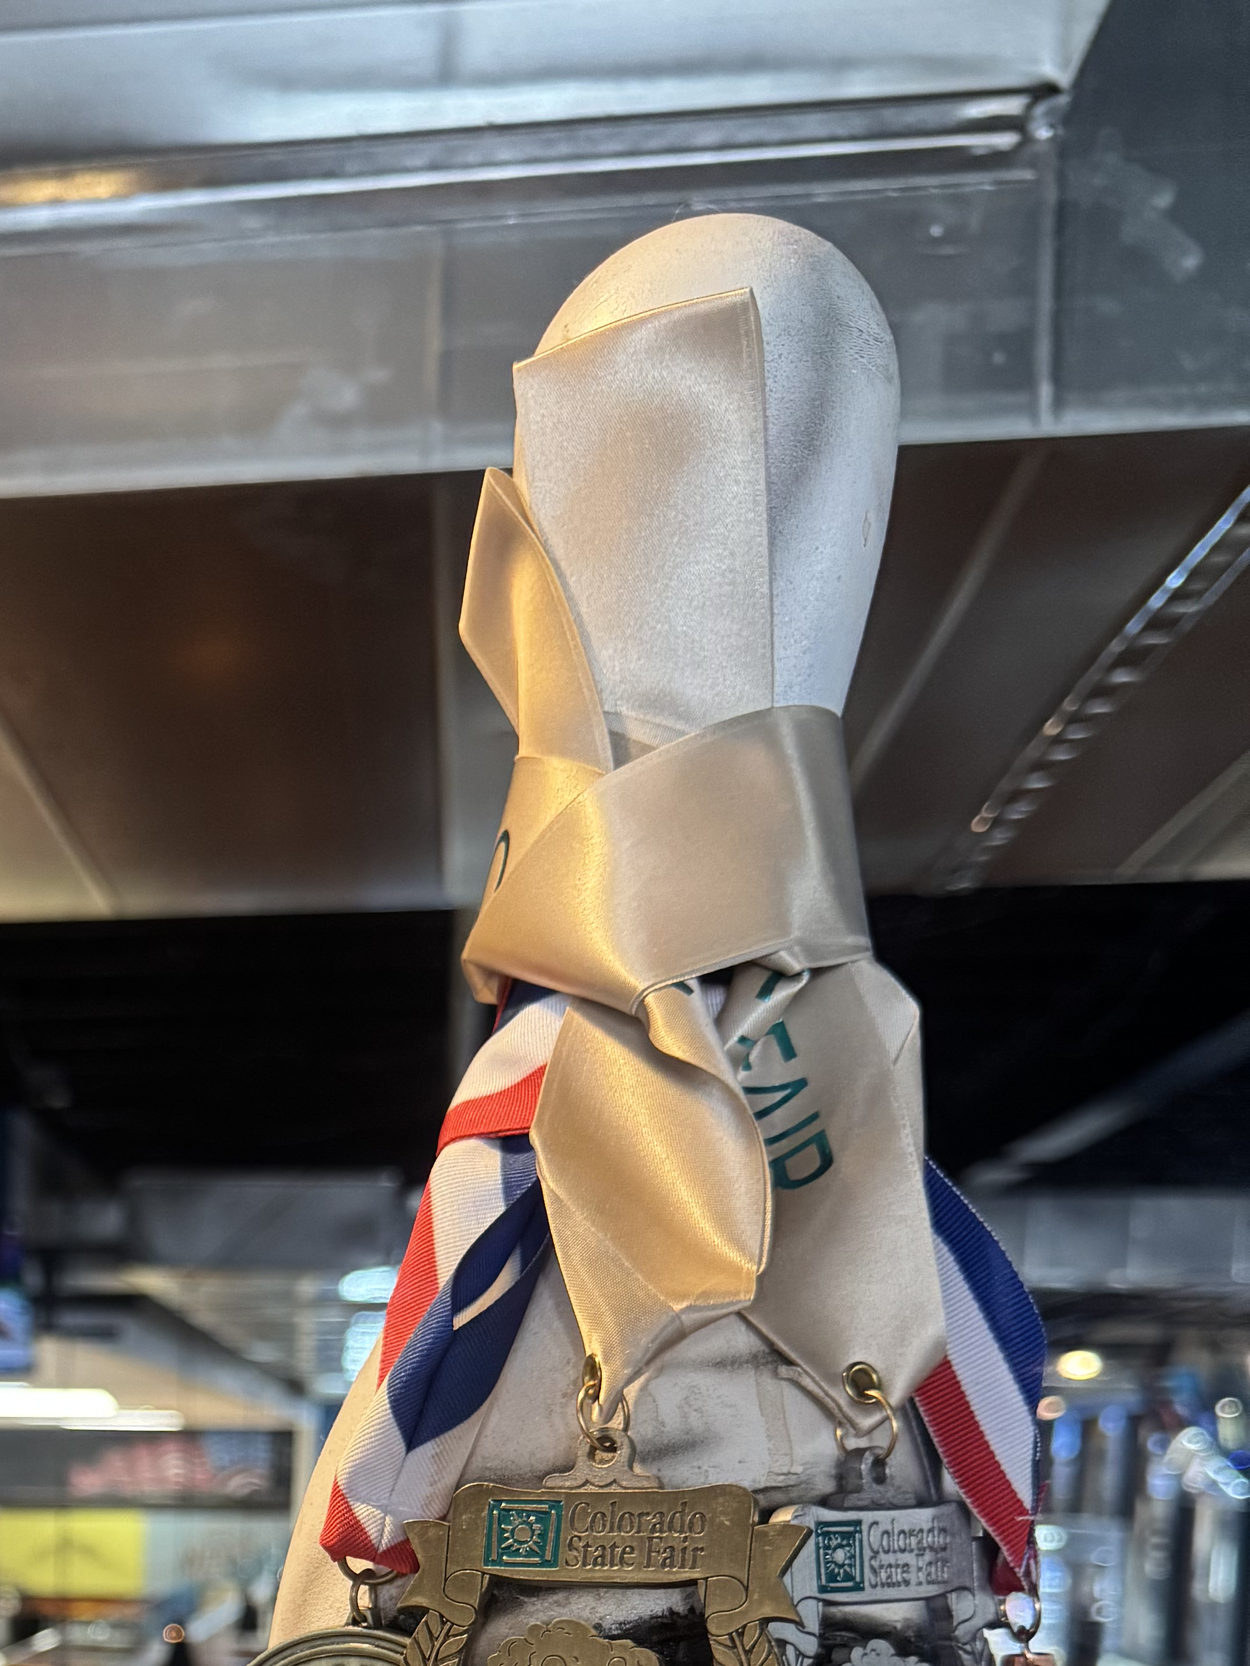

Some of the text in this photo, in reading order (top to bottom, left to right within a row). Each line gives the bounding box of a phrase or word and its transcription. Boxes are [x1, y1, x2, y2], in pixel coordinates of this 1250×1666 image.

[568, 1500, 707, 1536] Colorado
[564, 1535, 705, 1571] State Fair
[867, 1518, 949, 1555] Colorado
[868, 1553, 950, 1589] State Fair
